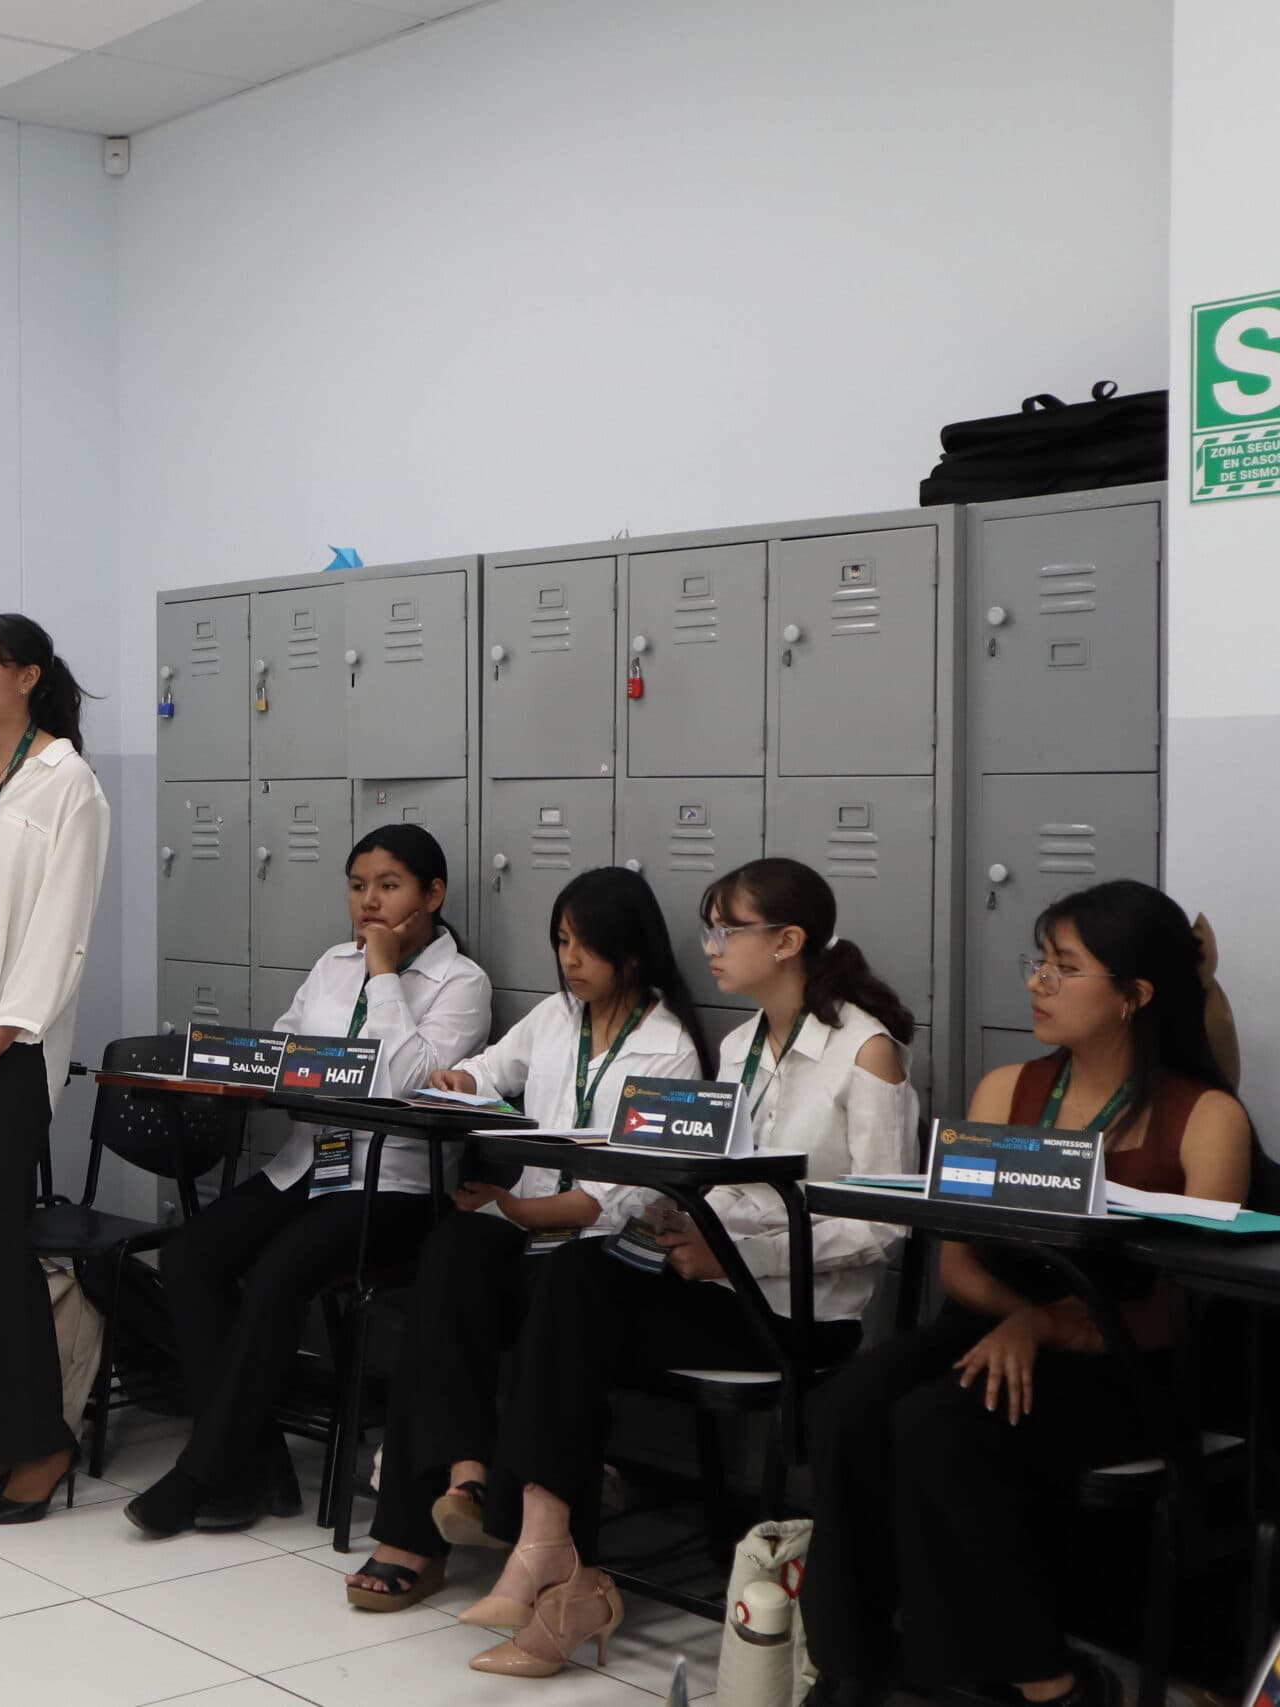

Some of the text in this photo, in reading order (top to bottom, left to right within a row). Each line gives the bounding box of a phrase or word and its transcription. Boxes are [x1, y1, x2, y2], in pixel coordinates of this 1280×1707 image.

[1213, 307, 1280, 415] S
[1210, 445, 1244, 458] ZONA
[1223, 458, 1239, 469] EN
[1220, 466, 1279, 482] DE SISMO
[254, 1051, 265, 1062] EL
[232, 1062, 279, 1076] SALVADO
[325, 1065, 366, 1084] HAITÍ
[671, 1119, 714, 1138] CUBA
[1043, 1139, 1093, 1149] MONTESSORI
[998, 1170, 1082, 1190] HONDURAS
